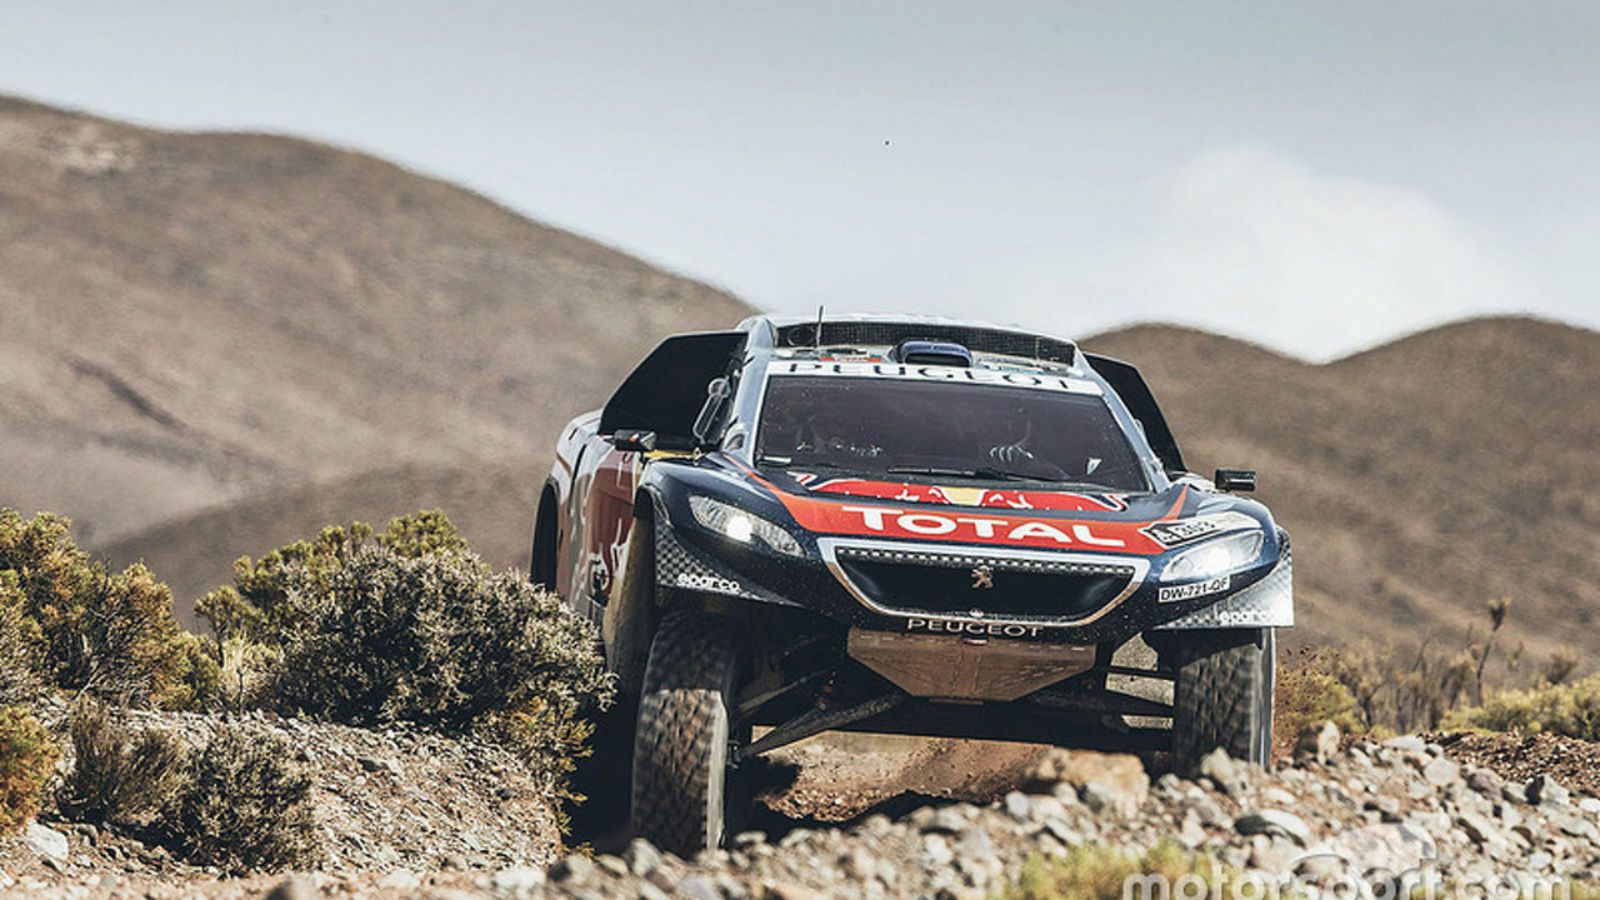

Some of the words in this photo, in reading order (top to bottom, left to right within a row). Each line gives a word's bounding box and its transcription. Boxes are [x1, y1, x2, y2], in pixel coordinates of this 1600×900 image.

[788, 362, 1073, 391] PEUGEOT
[842, 505, 1125, 547] TOTAL
[1160, 577, 1229, 601] DW-721-QF
[906, 617, 1043, 638] PEUGEOT
